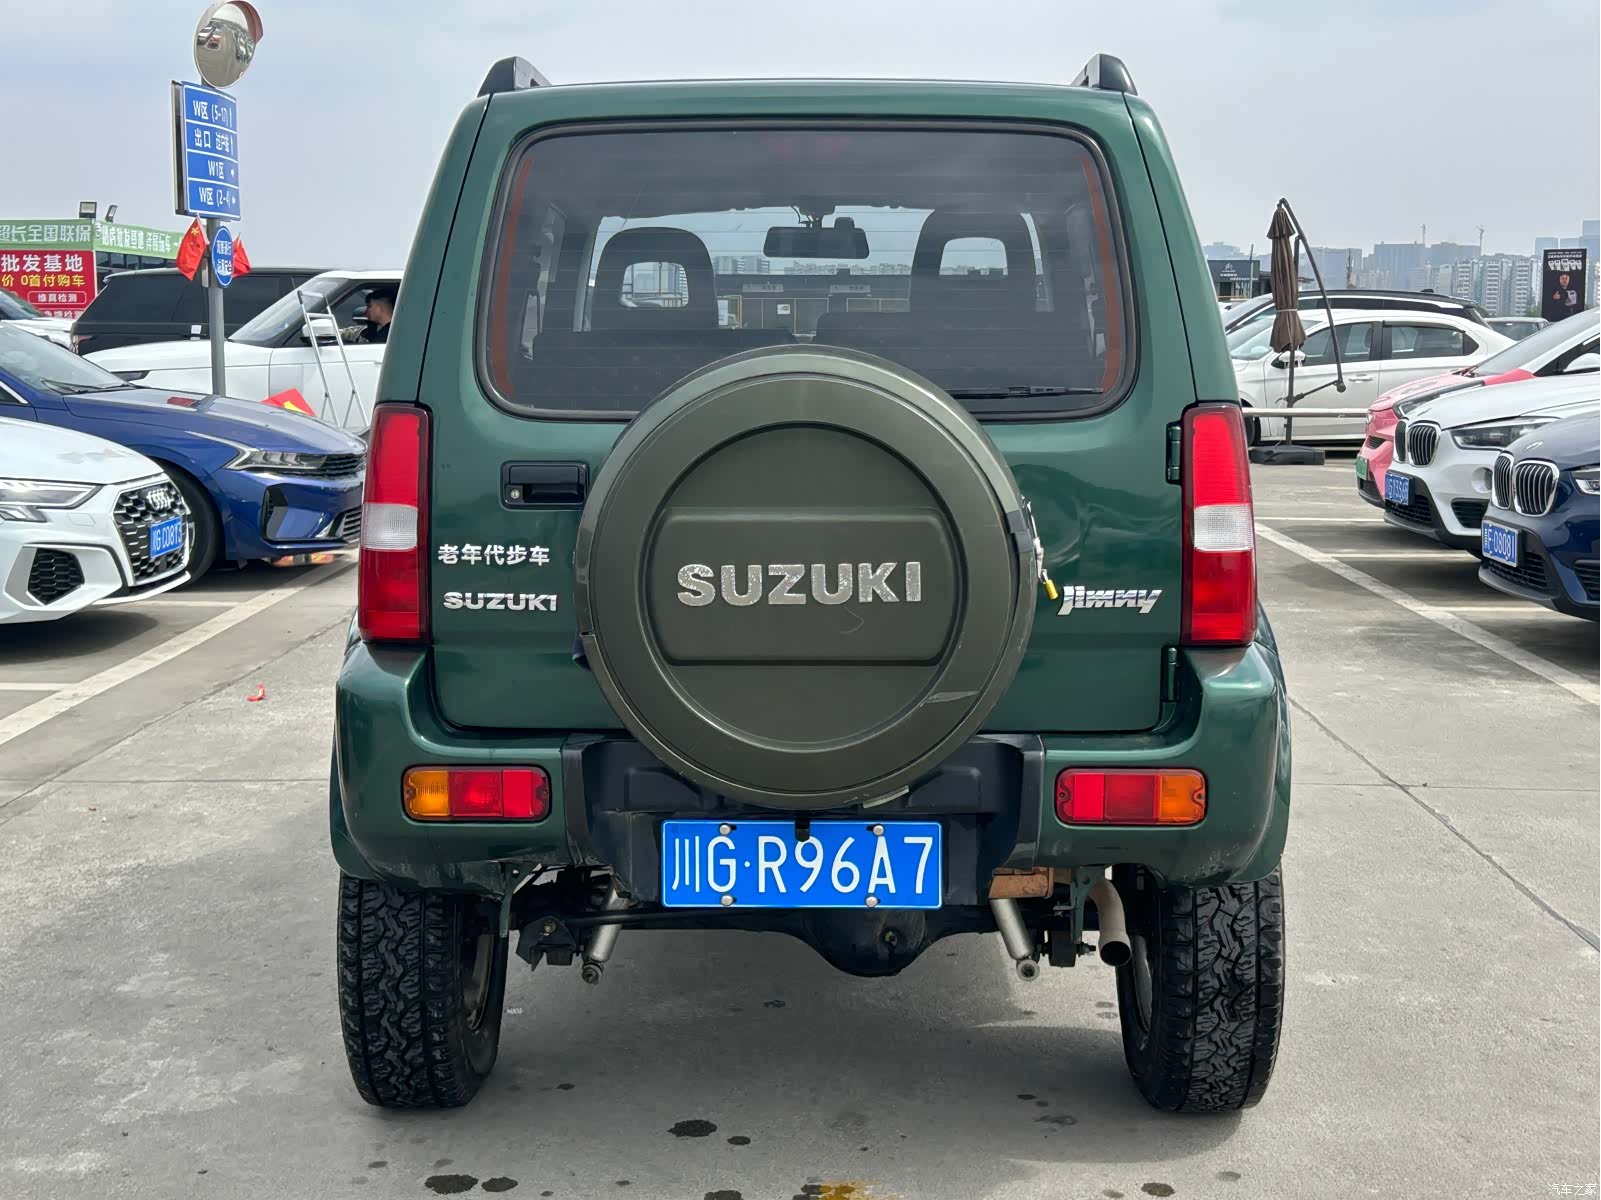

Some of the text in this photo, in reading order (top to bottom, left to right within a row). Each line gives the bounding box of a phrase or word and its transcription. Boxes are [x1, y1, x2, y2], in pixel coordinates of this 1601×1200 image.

[194, 128, 211, 149] 出口
[208, 160, 224, 180] W1区
[1, 254, 83, 272] 批发基地
[438, 543, 550, 566] 老年代步车
[677, 561, 921, 606] SUZUKI
[443, 591, 558, 612] SUZUKI
